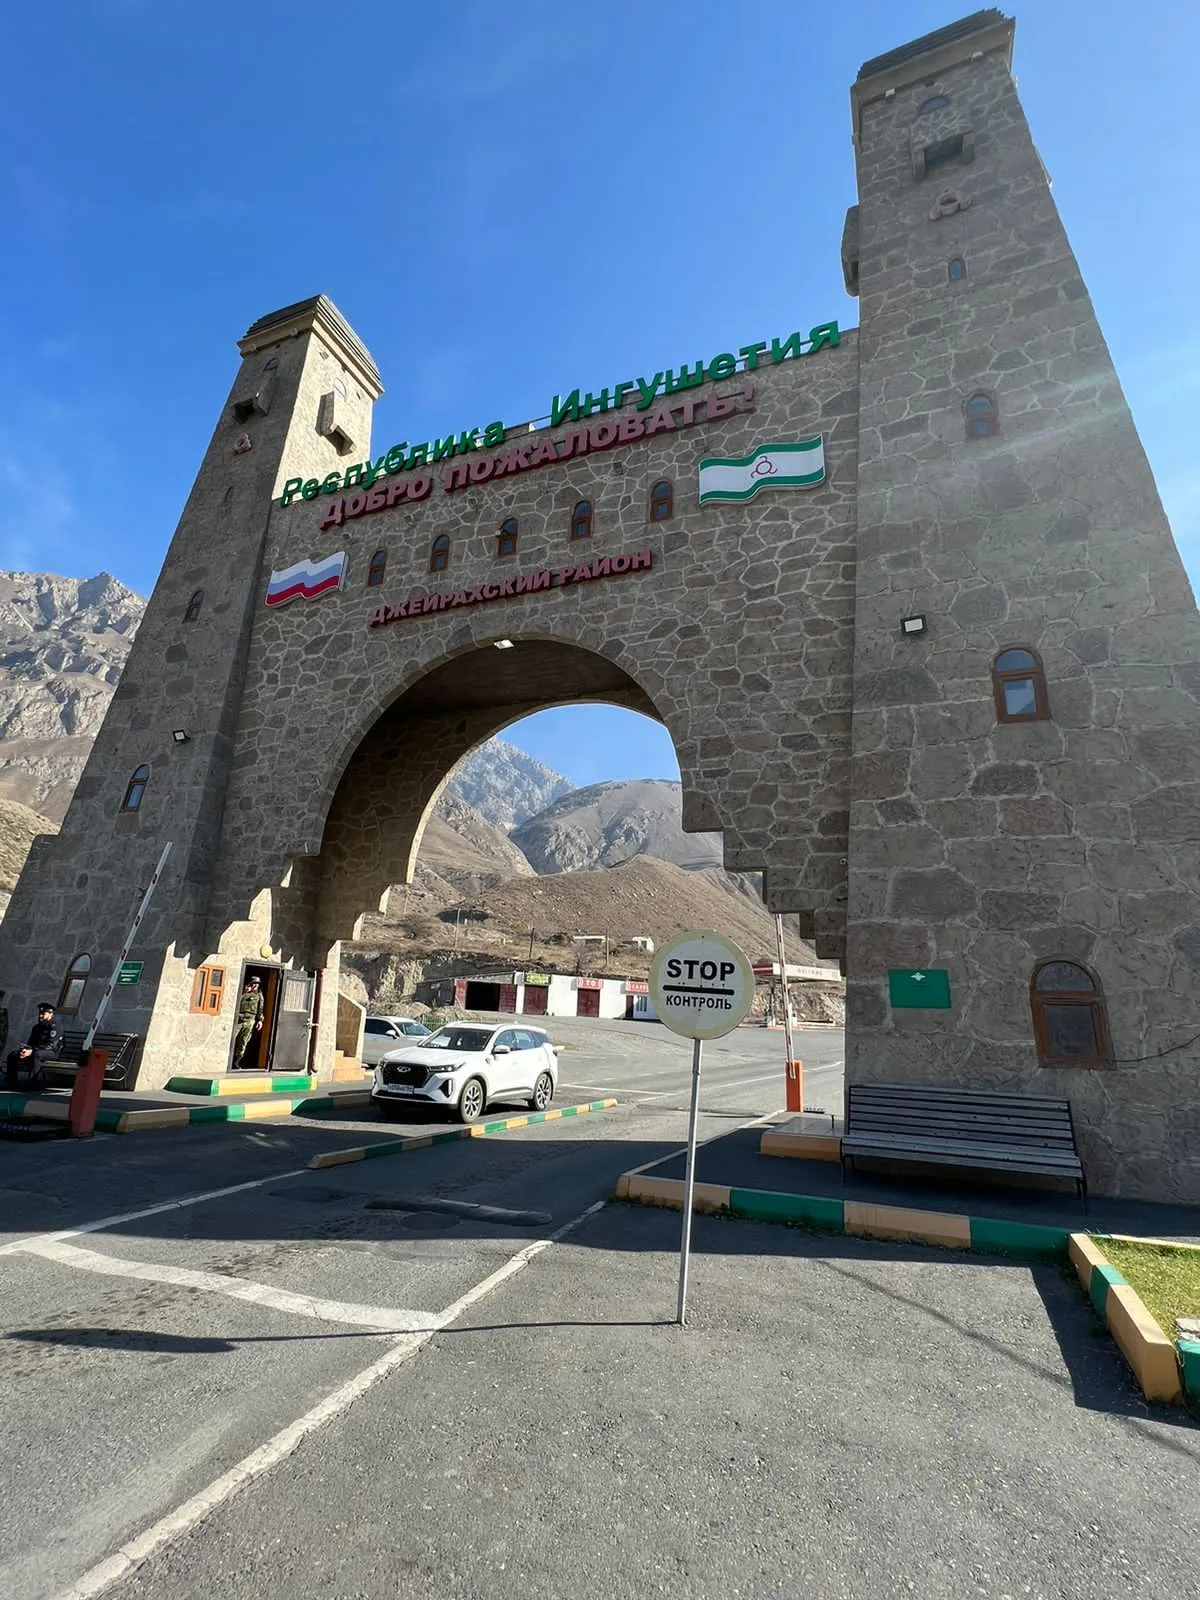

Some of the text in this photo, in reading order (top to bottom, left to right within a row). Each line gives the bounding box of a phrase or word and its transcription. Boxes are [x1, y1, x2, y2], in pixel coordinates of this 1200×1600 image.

[280, 320, 840, 507] Республика Ингушетия
[320, 382, 754, 530] ДОБРО ПОЖАЛОВАТЬ!
[666, 995, 732, 1010] КОНТРОЛЬ
[667, 959, 736, 982] STOP
